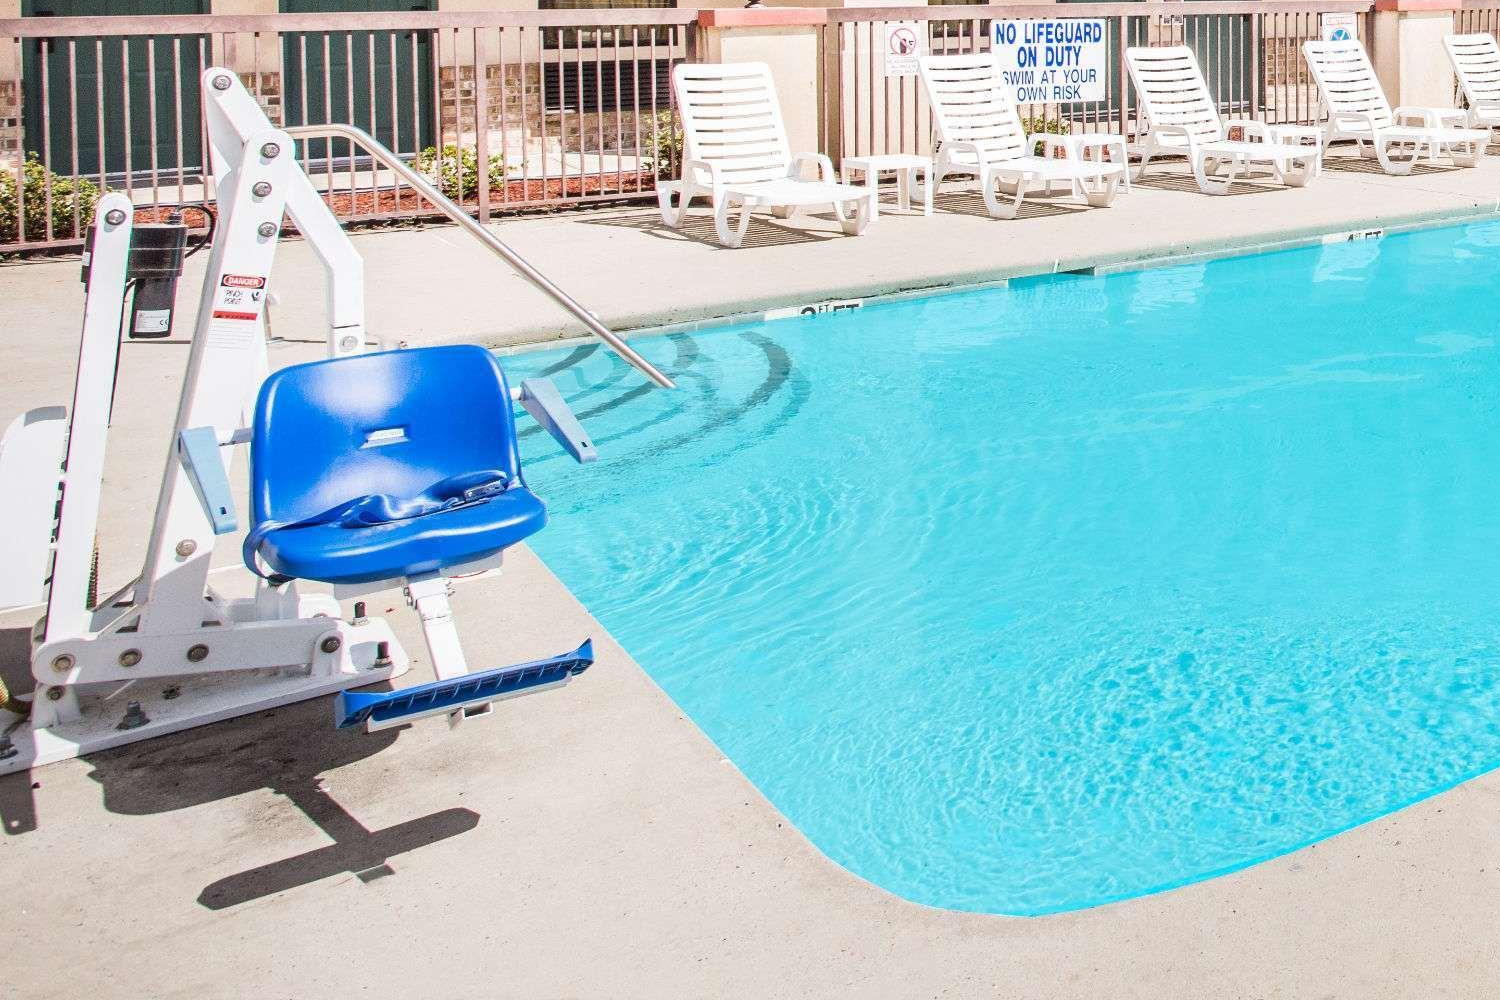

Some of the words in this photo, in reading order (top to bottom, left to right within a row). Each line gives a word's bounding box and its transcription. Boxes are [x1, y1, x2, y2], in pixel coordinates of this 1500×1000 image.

[995, 22, 1017, 45] NO
[1024, 22, 1102, 44] LIFEGUARD
[1017, 46, 1037, 68] ON
[1045, 45, 1082, 67] DUTY
[1002, 70, 1034, 85] SWIM
[1040, 69, 1057, 84] AT
[1063, 68, 1097, 84] YOUR
[1017, 86, 1047, 102] OWN
[1053, 84, 1082, 100] RISK
[227, 275, 259, 287] DANGER
